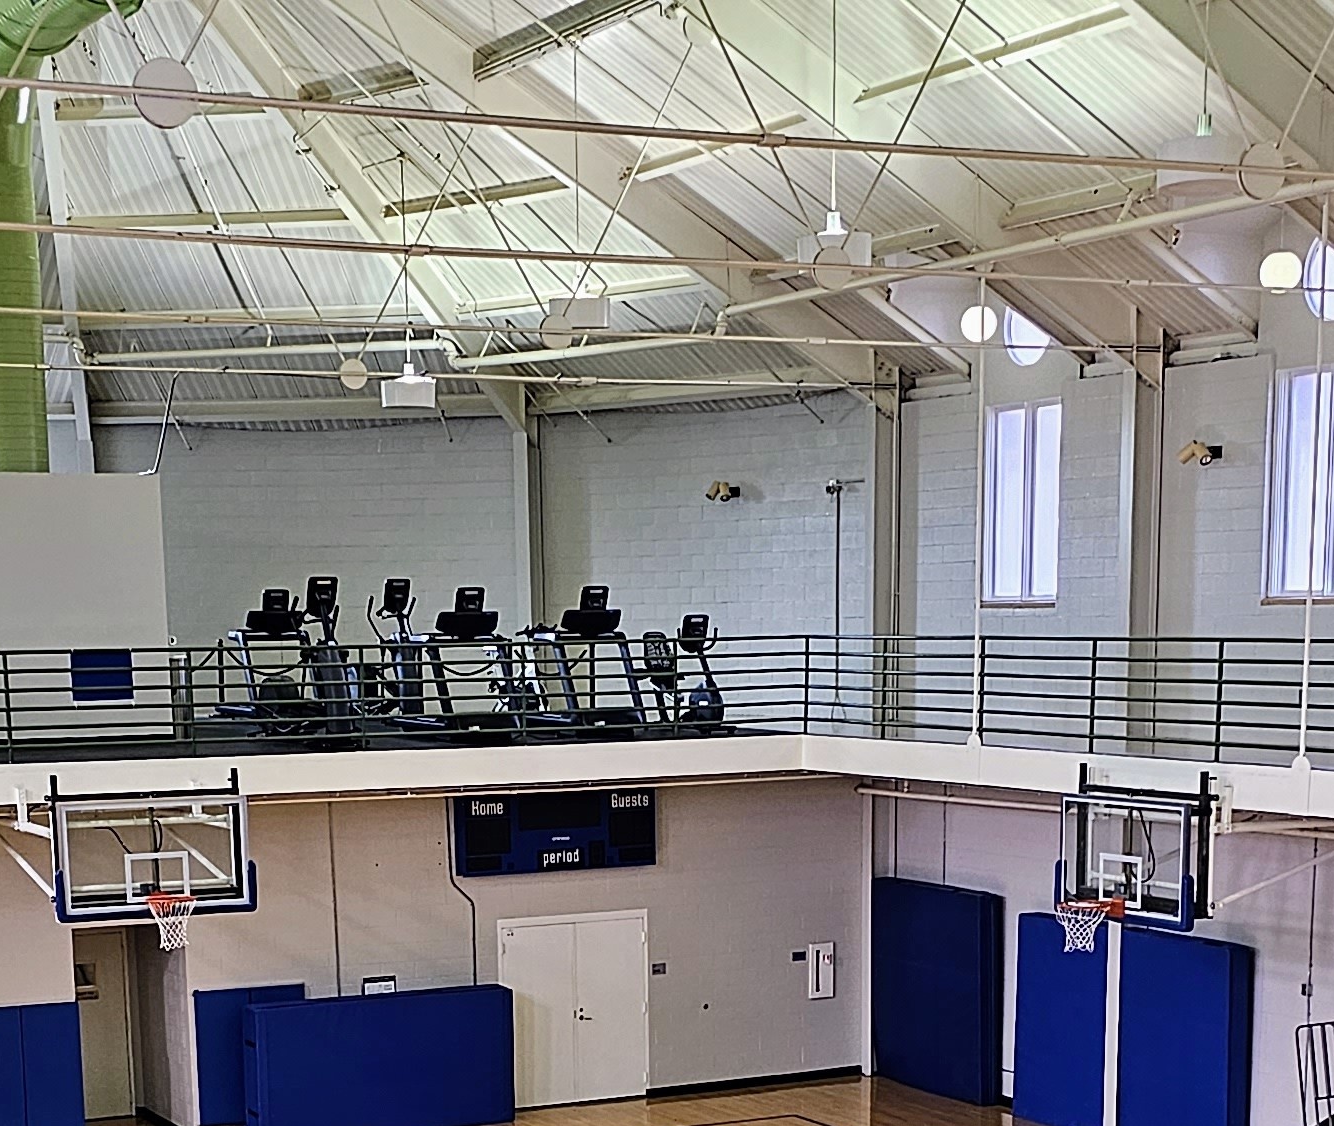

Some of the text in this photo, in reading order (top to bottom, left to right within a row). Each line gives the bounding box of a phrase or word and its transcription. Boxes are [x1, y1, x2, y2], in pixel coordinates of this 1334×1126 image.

[471, 801, 504, 815] Home
[611, 793, 649, 808] Guests
[543, 848, 580, 867] period
